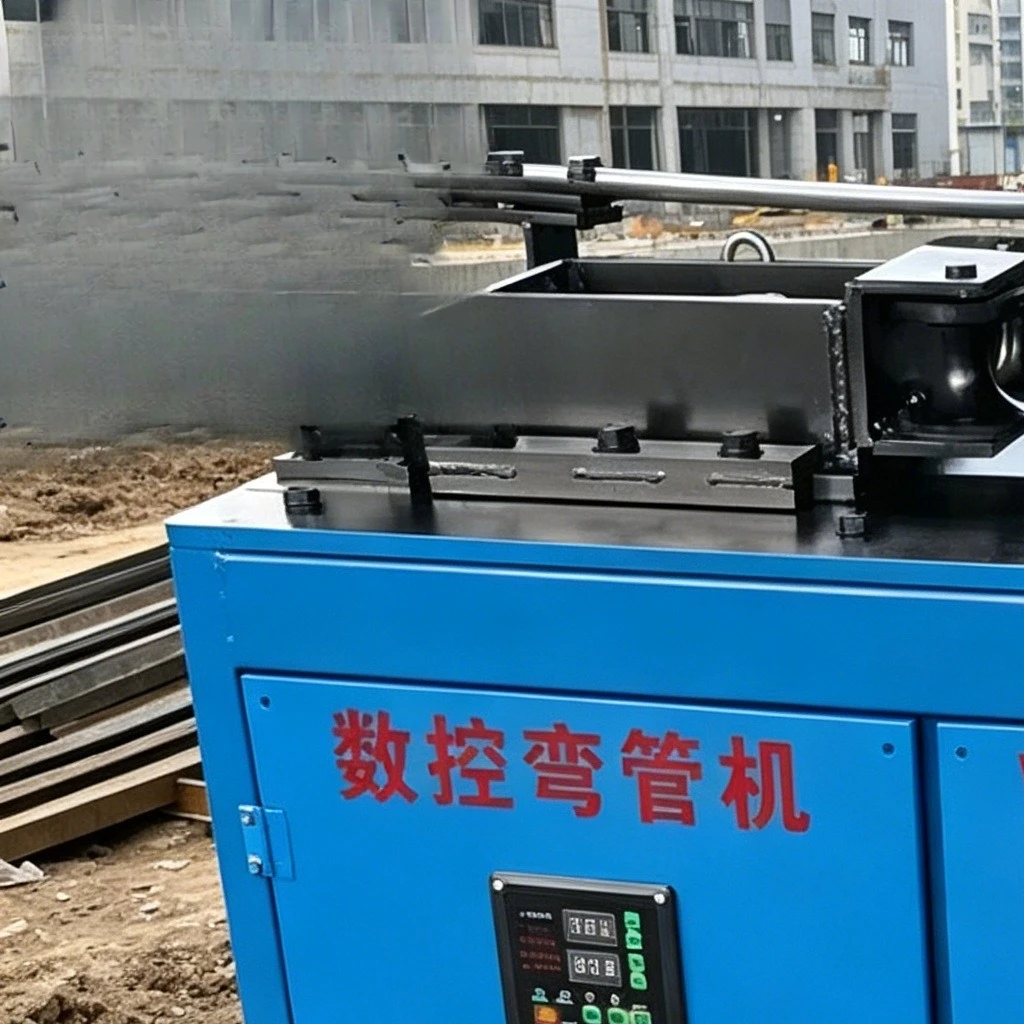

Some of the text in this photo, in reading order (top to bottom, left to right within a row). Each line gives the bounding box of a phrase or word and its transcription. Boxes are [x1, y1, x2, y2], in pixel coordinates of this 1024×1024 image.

[332, 708, 811, 833] 数控弯管机
